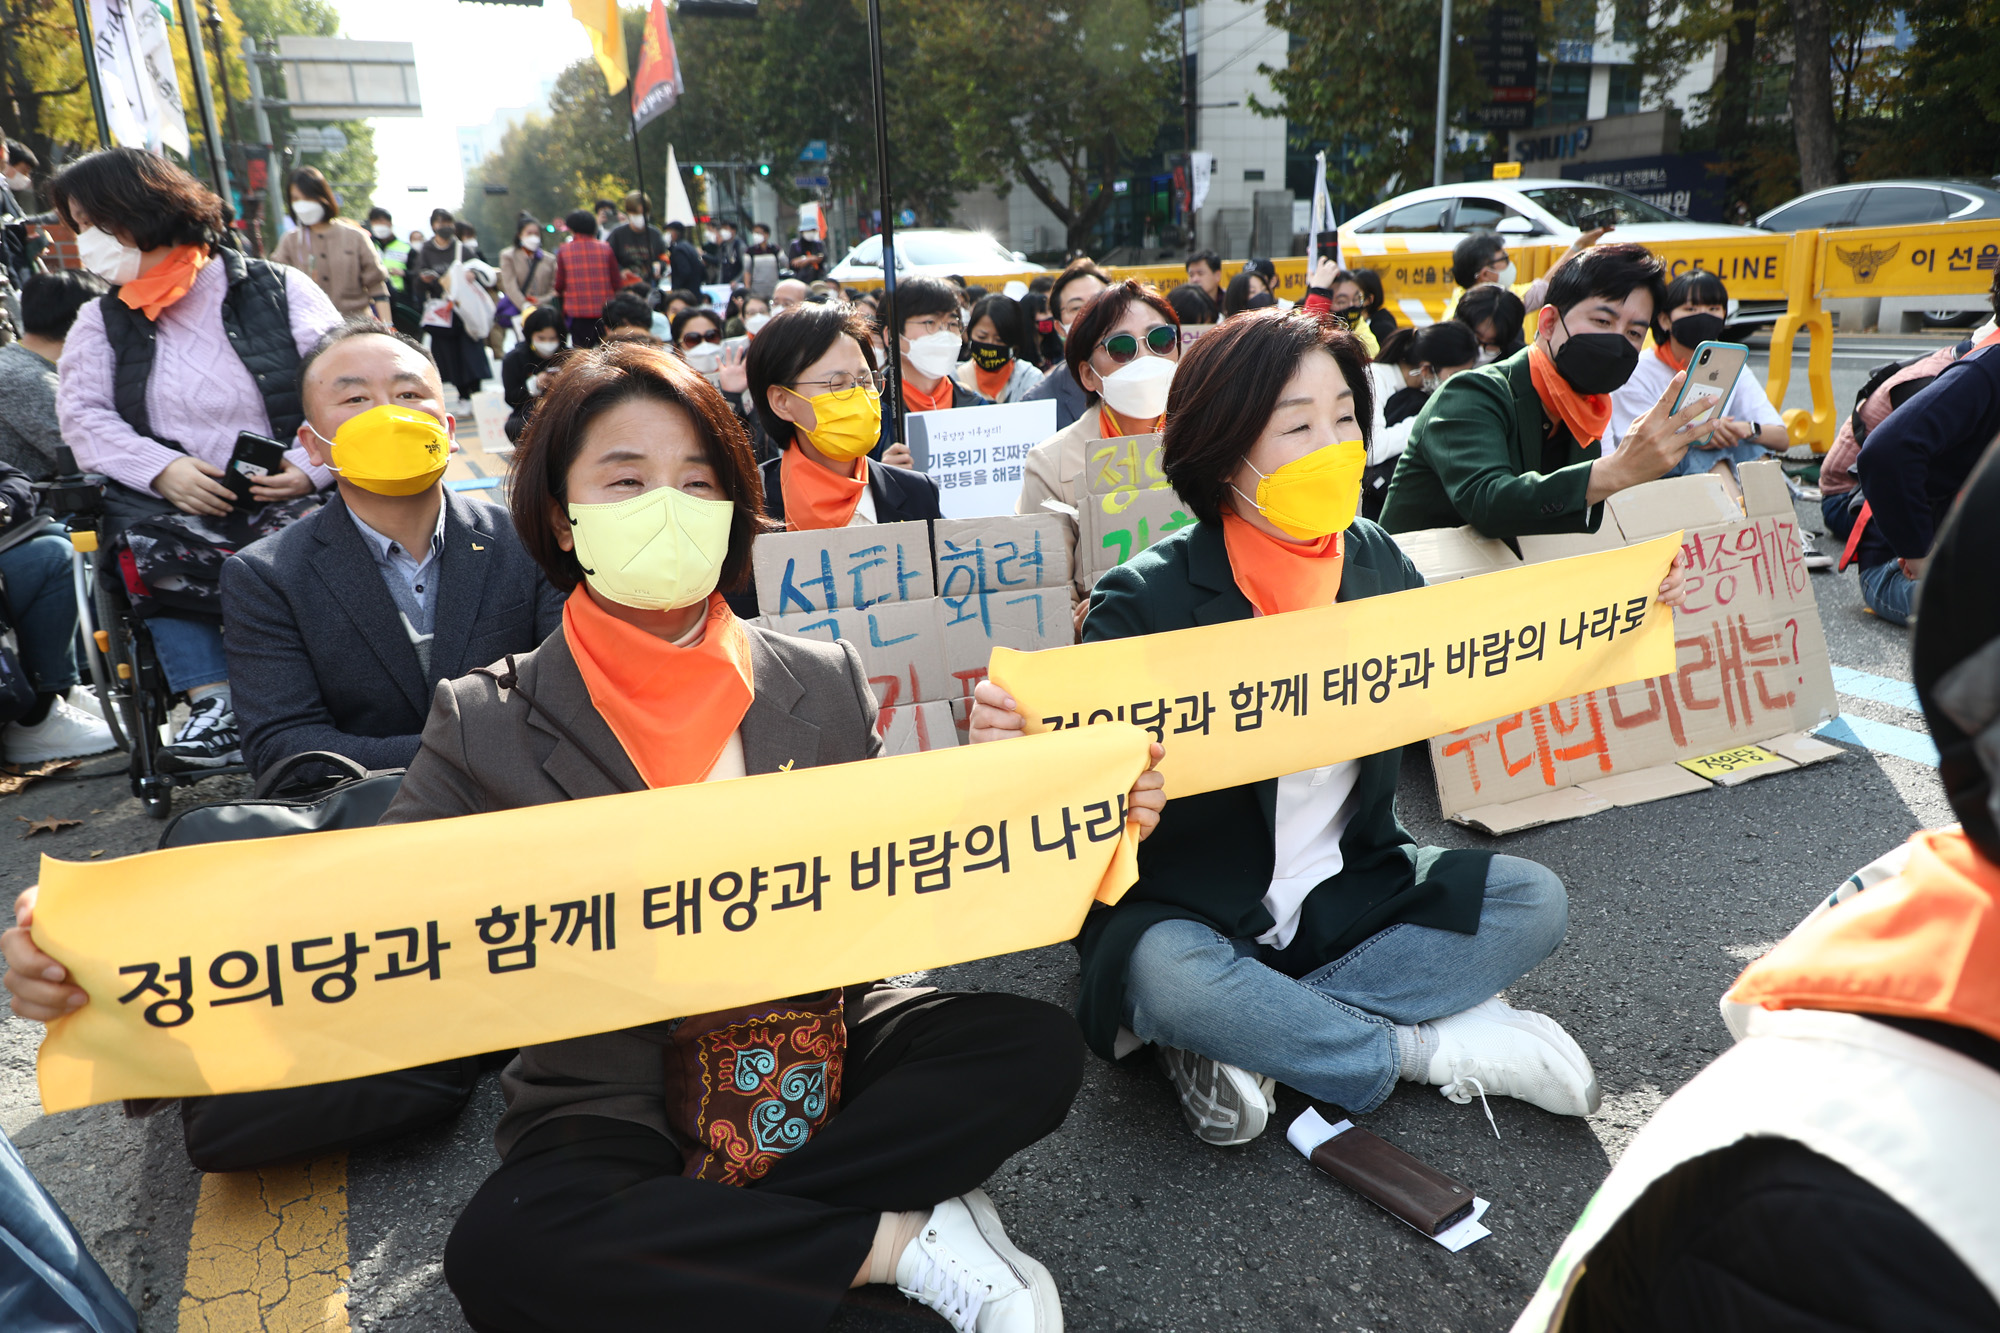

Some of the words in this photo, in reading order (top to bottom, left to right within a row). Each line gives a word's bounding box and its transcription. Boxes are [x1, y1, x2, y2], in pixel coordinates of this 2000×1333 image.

[1718, 256, 1778, 280] LINE
[1911, 248, 1936, 273] 이
[1947, 244, 2000, 272] 선을
[1284, 272, 1307, 289] 넘지
[1396, 268, 1408, 284] 이
[1413, 267, 1437, 283] 선을
[933, 431, 965, 441] 지금당장
[967, 425, 1002, 438] 기후정의!
[928, 448, 987, 469] 기후위기
[992, 442, 1040, 463] 진짜원
[992, 465, 1025, 483] 해결
[779, 543, 922, 648] 석탄
[940, 529, 1047, 639] 화력
[1229, 672, 1308, 732] 함께
[1323, 647, 1435, 704] 태양과
[1446, 621, 1546, 679] 바람의
[1558, 596, 1648, 650] 나라로
[1696, 749, 1764, 771] 정의당
[118, 919, 450, 1028] 정의당과
[474, 892, 617, 975] 함께
[642, 856, 831, 937] 태양과
[851, 820, 1010, 898] 바람의
